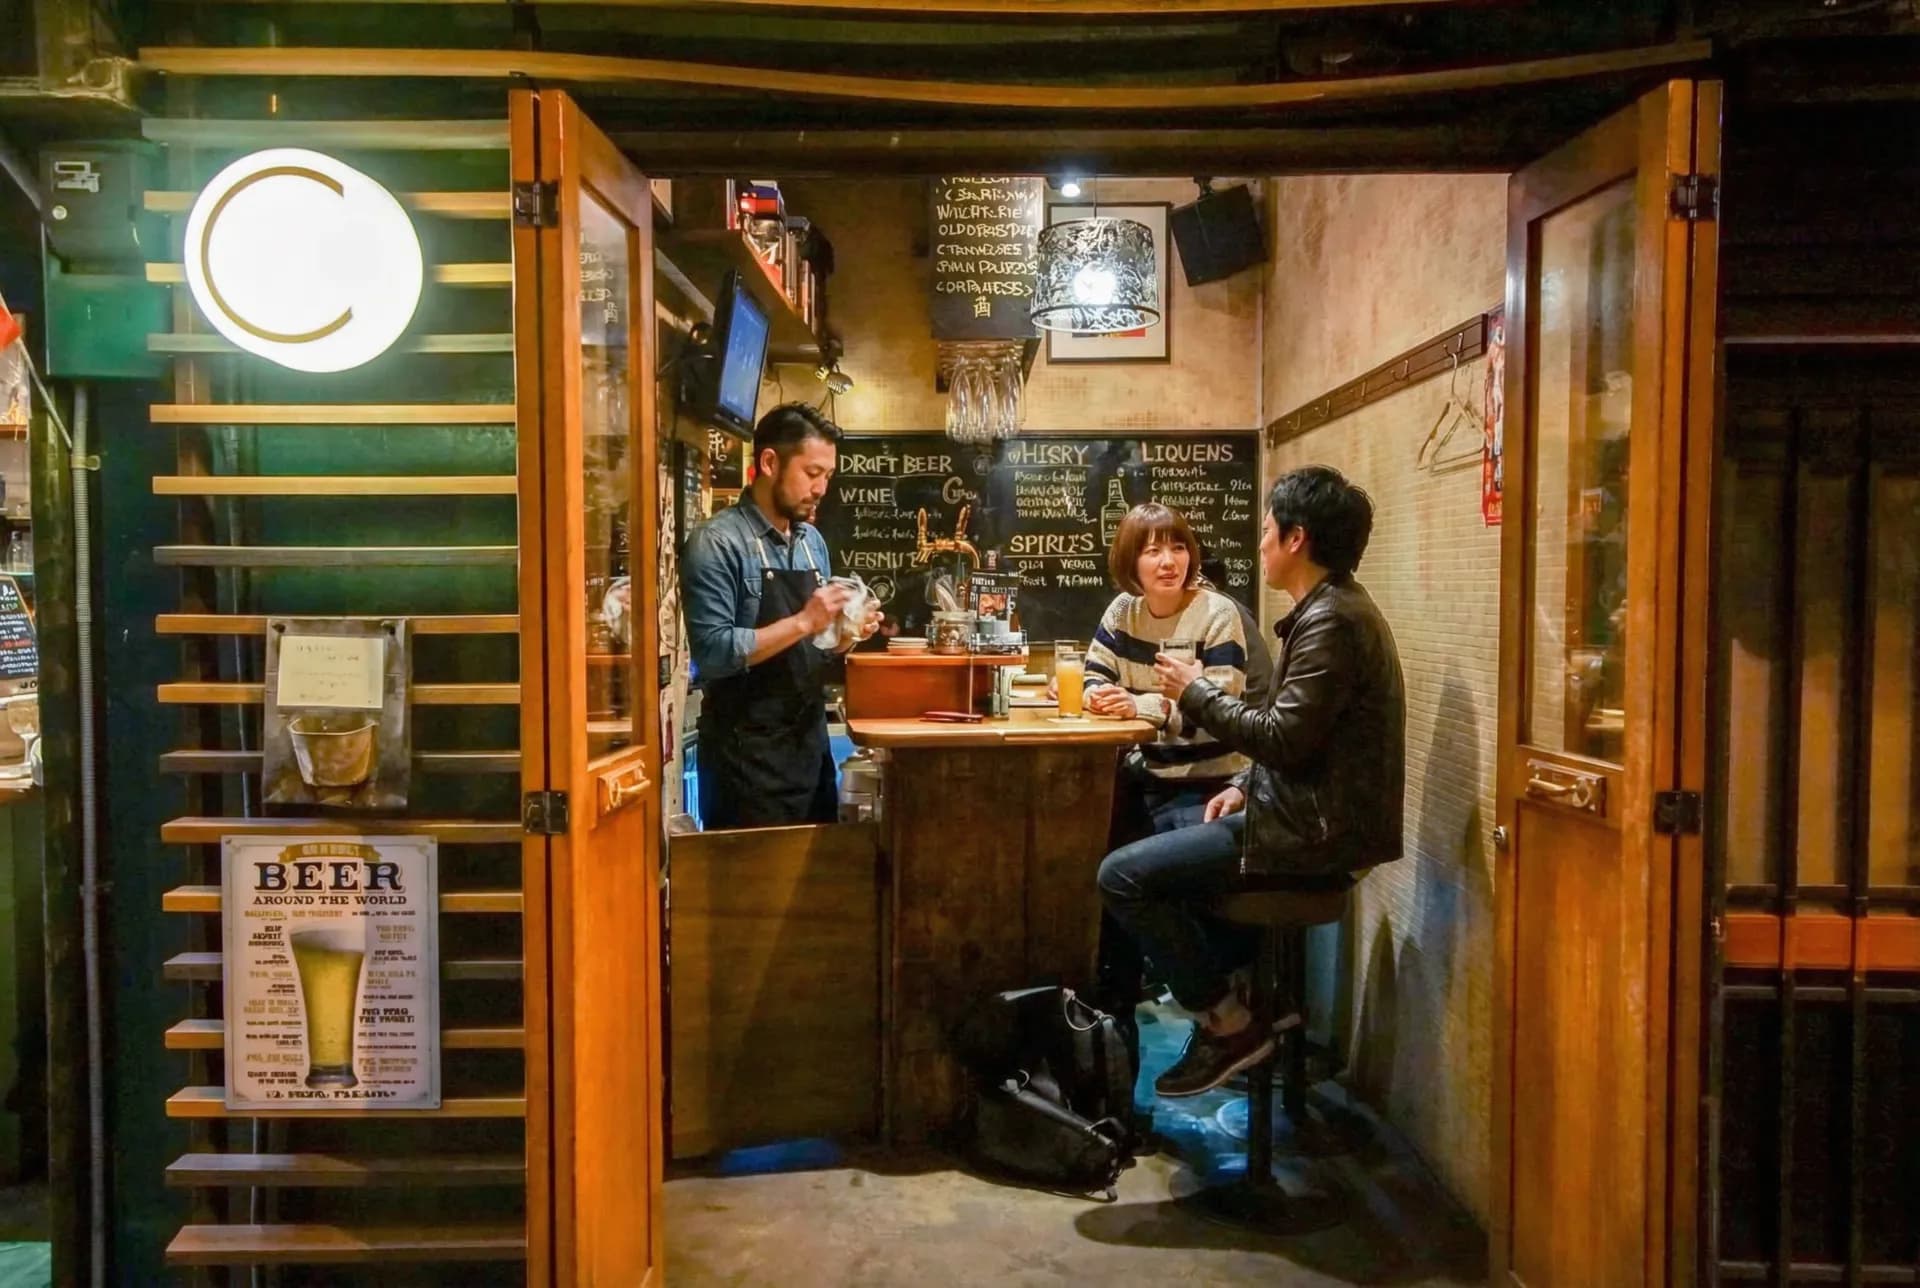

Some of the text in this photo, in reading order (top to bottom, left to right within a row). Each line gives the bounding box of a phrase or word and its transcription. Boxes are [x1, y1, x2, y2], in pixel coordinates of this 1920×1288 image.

[903, 454, 953, 474] BEER
[840, 487, 892, 504] WINE
[254, 862, 404, 893] BEER
[253, 896, 407, 905] AROUND THE WORLD
